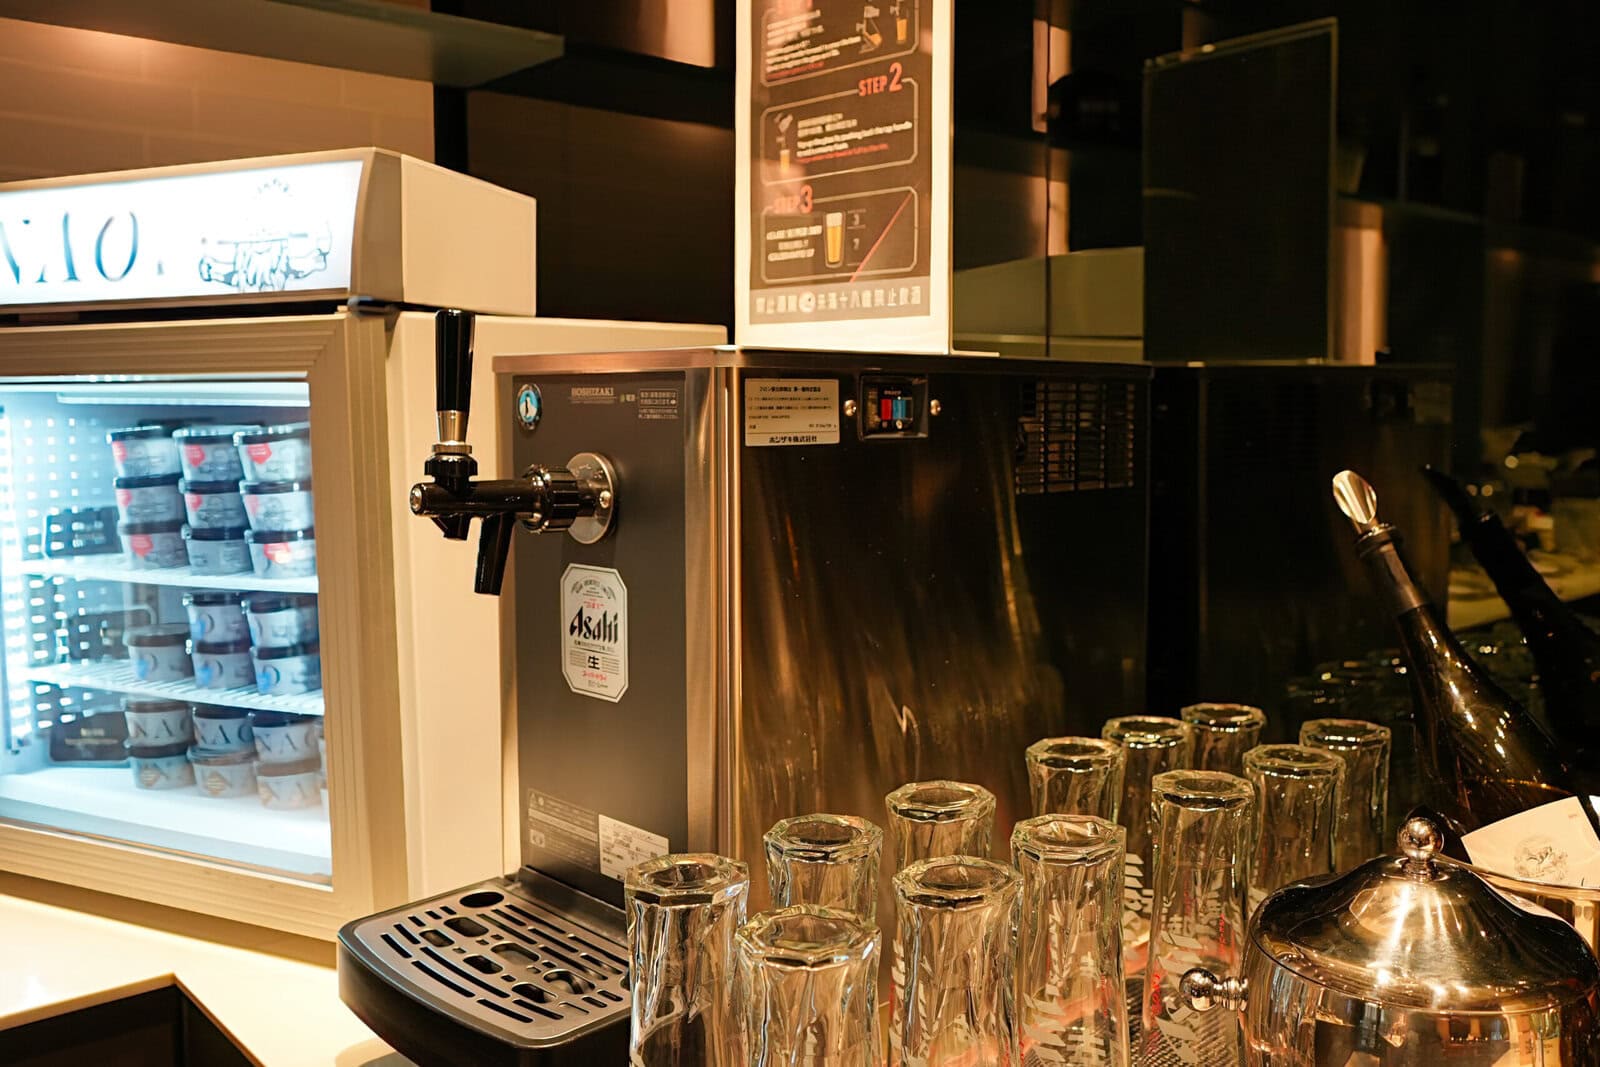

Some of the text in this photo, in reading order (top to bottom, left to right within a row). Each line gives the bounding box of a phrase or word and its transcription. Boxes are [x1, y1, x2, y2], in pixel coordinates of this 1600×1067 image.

[858, 62, 903, 97] STEP 2
[569, 606, 619, 645] Asahi
[587, 655, 601, 671] 生
